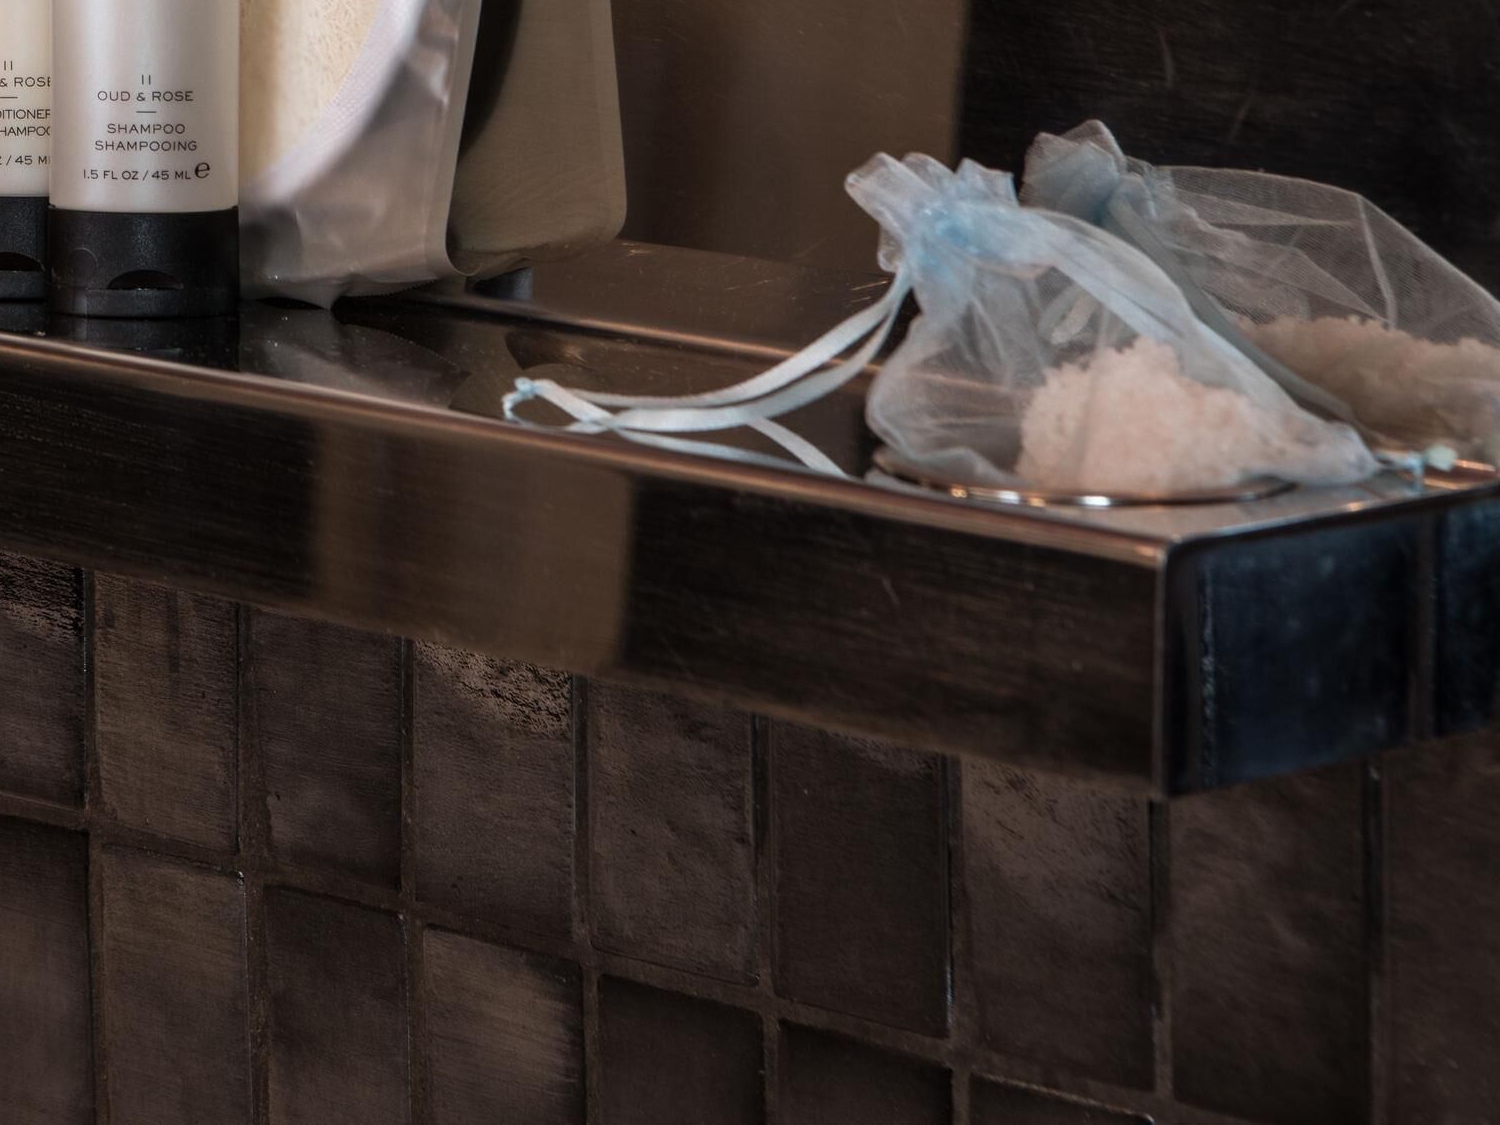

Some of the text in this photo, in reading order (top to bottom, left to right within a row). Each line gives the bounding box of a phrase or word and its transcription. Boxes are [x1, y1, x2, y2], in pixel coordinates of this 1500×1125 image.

[98, 90, 194, 102] OUD & ROSE
[107, 124, 186, 135] SHAMPOO
[95, 140, 198, 152] SHAMPOOING
[14, 156, 33, 166] 45
[84, 169, 98, 180] 1.5
[104, 170, 118, 180] FL
[122, 170, 139, 180] OZ
[151, 170, 170, 180] 45
[174, 170, 192, 180] ML
